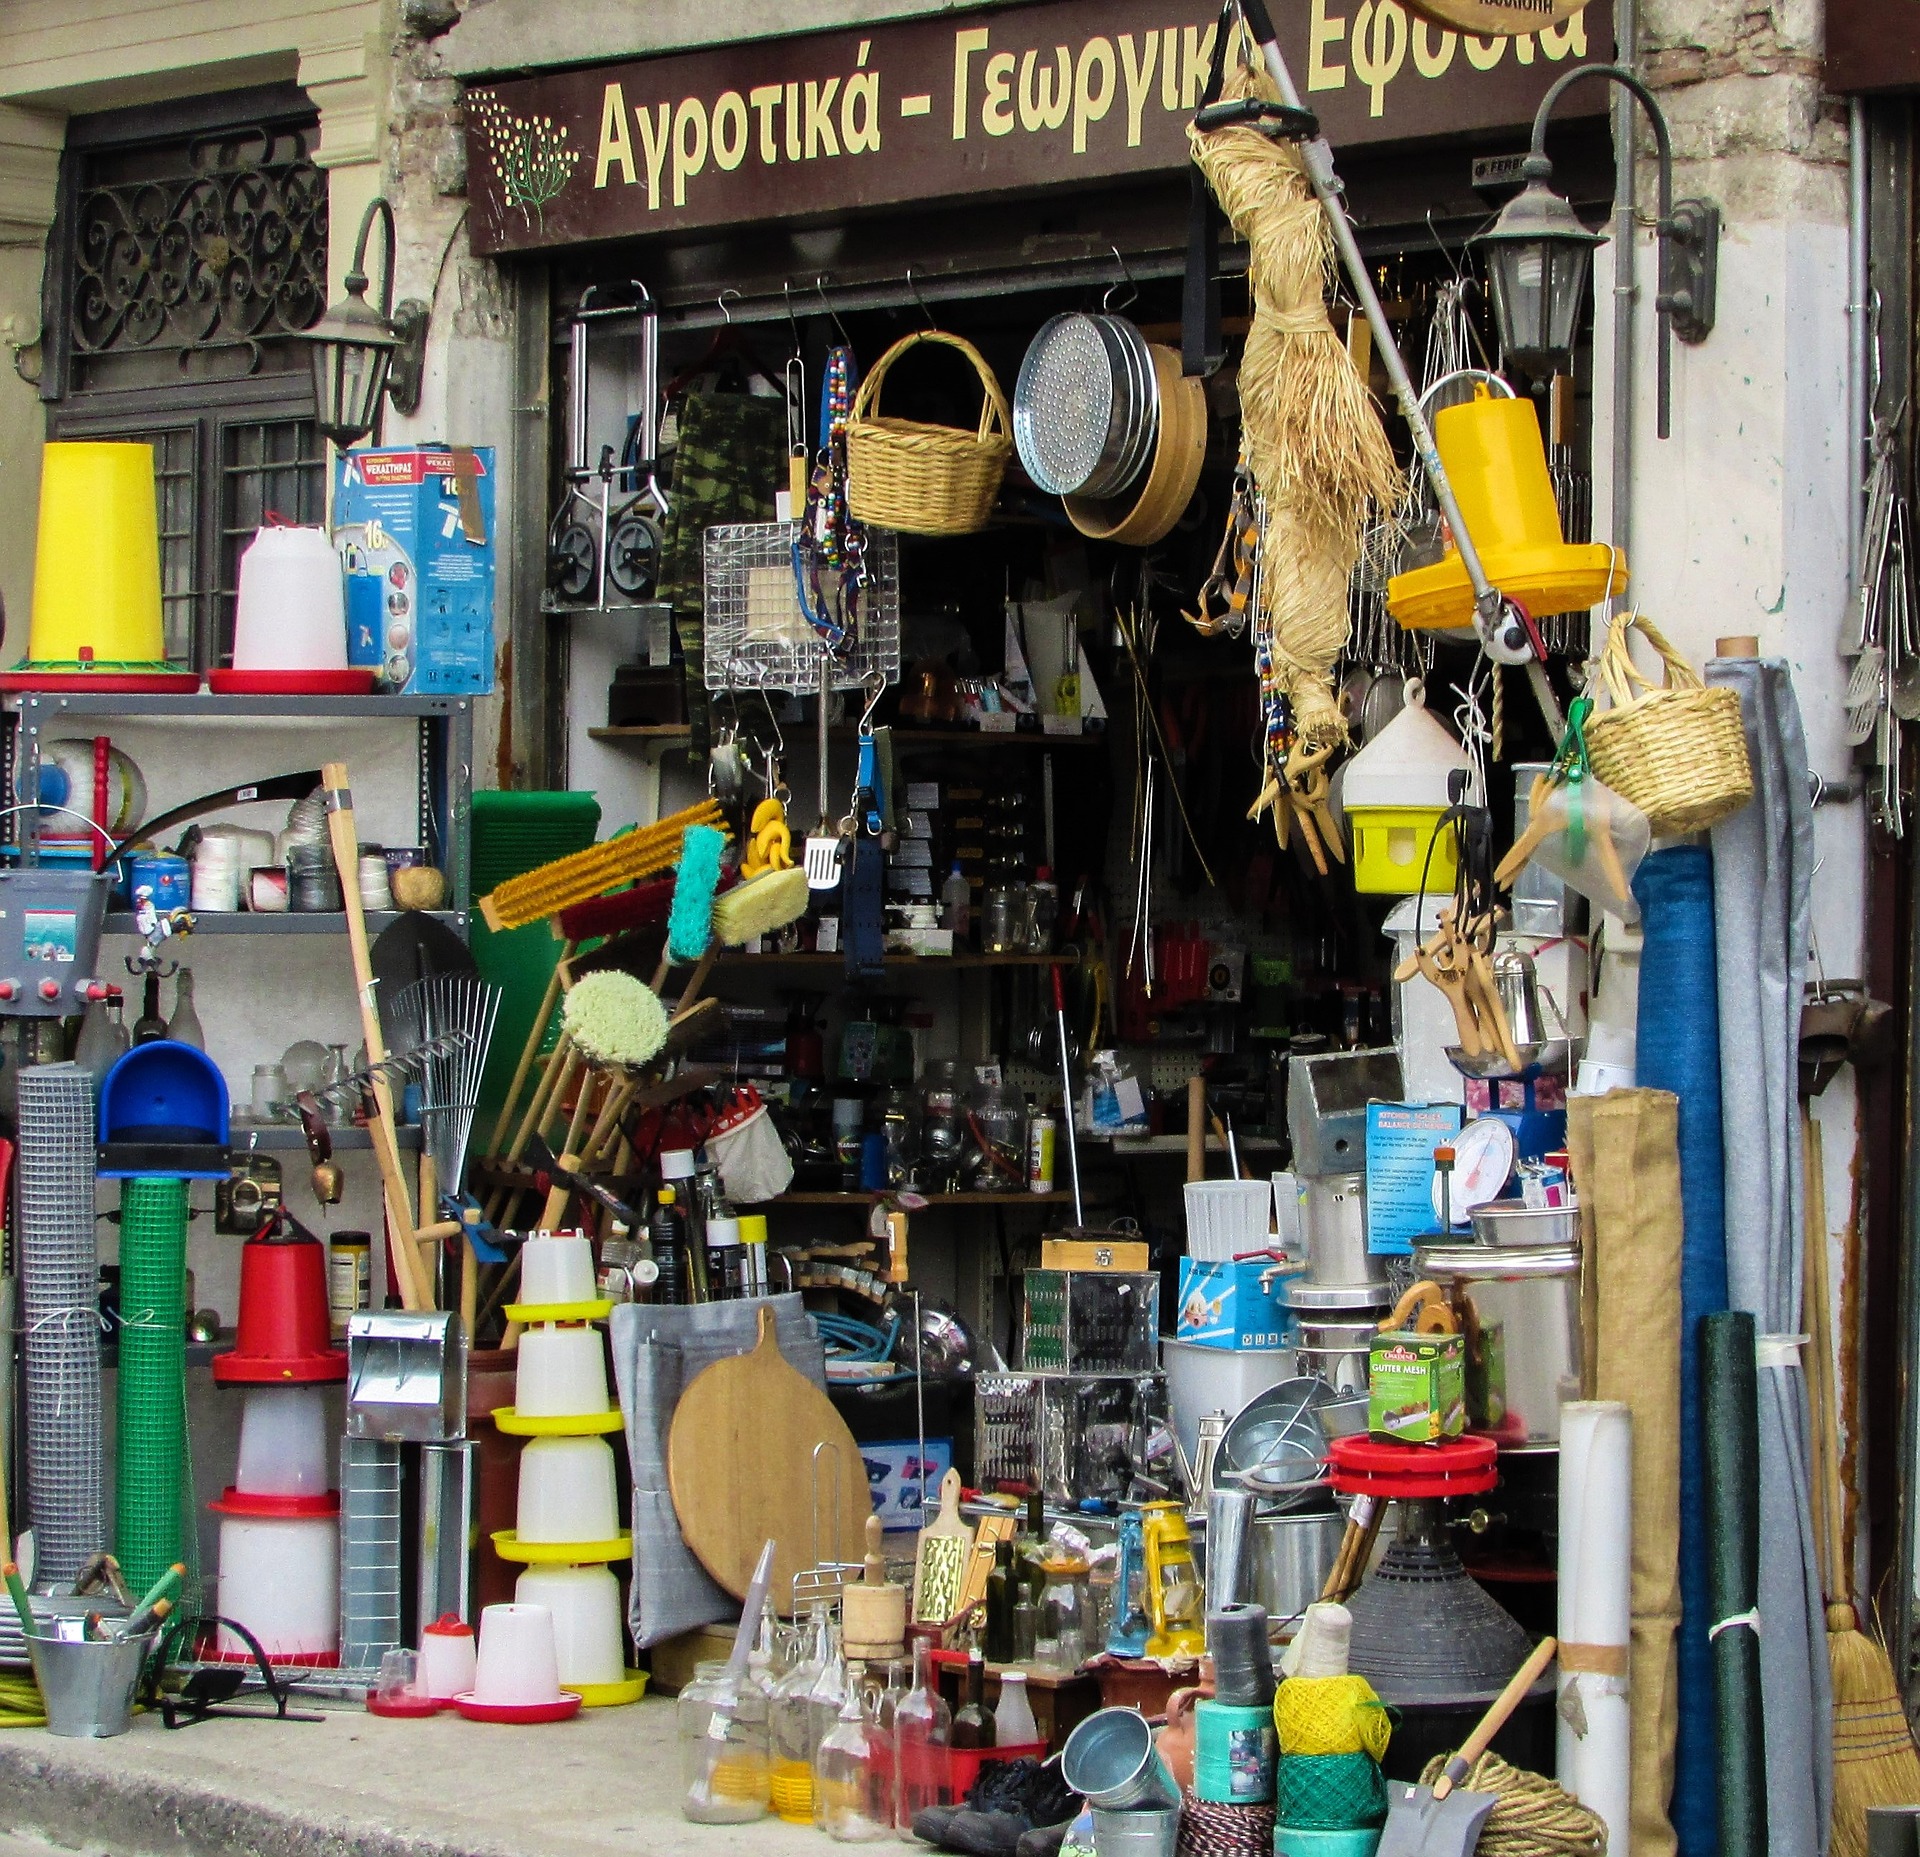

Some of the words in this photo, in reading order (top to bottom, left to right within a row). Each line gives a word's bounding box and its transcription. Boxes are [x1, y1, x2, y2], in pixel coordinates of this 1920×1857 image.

[594, 40, 882, 211] Αγροτικά
[366, 463, 412, 475] ΨΕΚΑΣΤΗΡΑΣ
[1372, 1363, 1402, 1373] GUTTER
[1403, 1365, 1427, 1375] MESH
